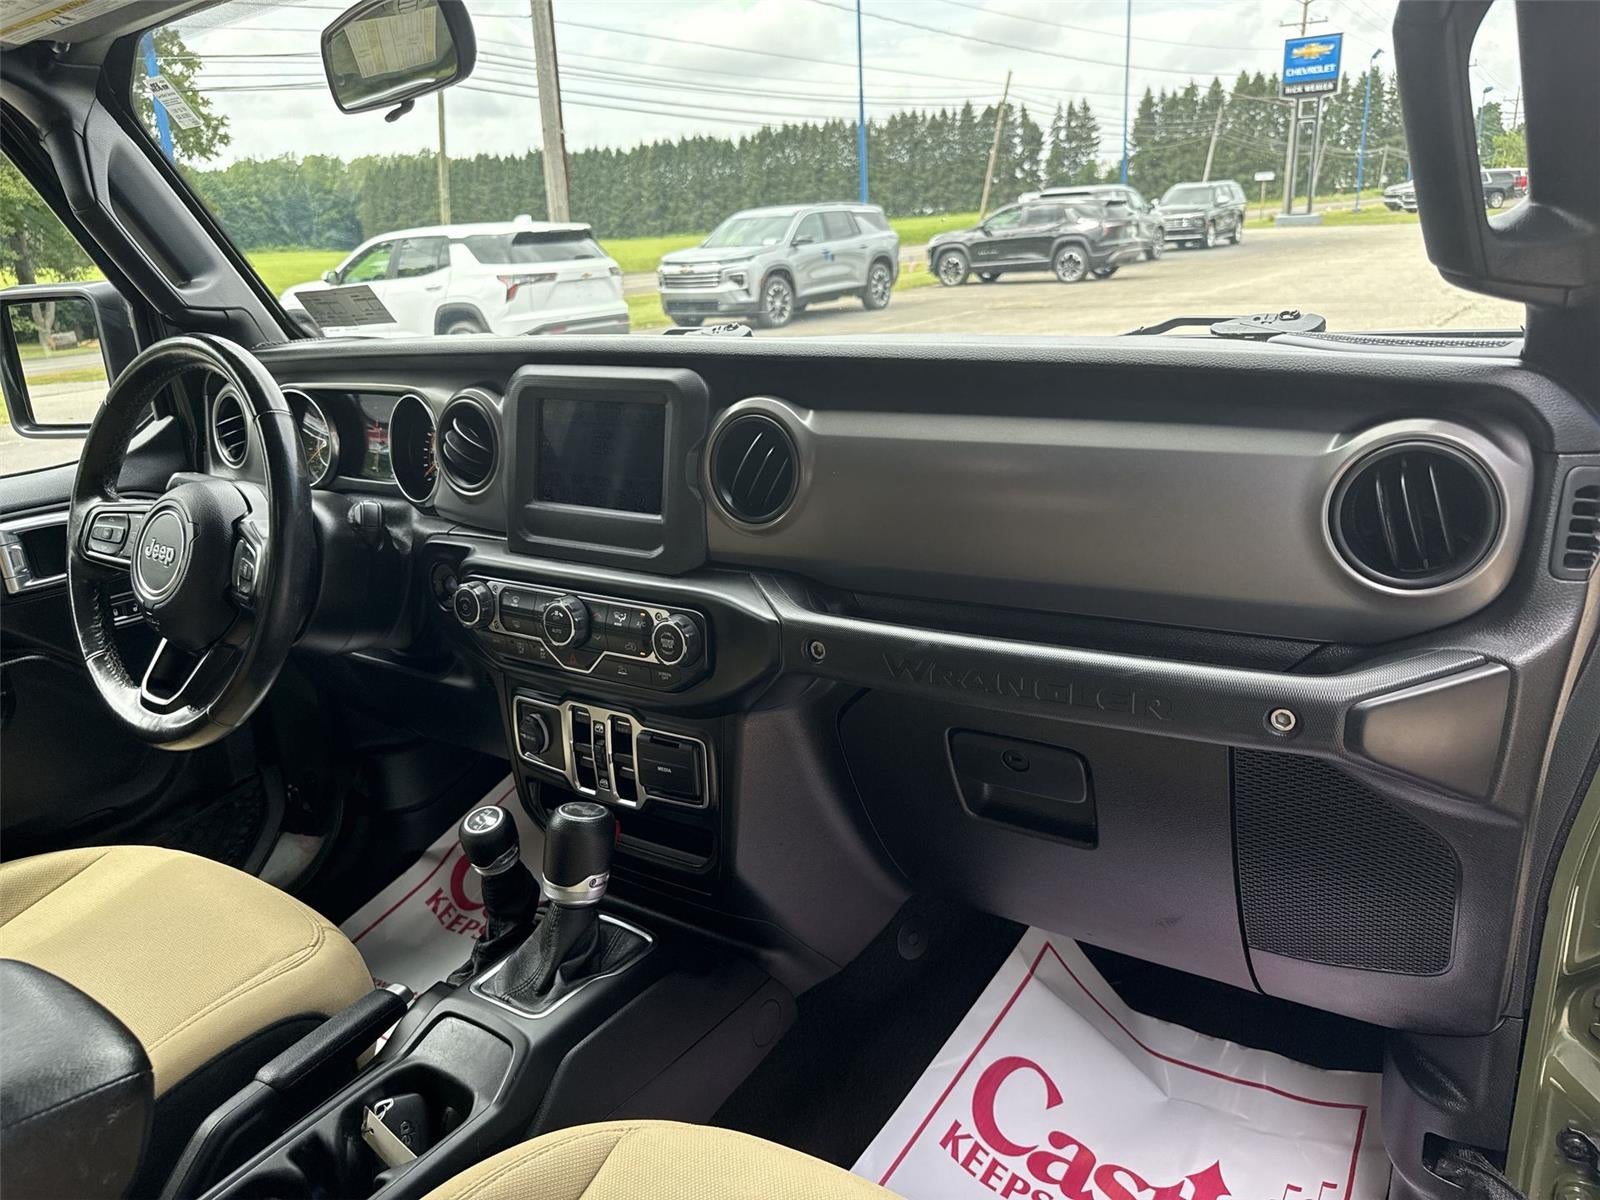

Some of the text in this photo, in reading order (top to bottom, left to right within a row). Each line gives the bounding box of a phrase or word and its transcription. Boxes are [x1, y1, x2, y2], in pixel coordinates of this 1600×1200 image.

[1285, 64, 1336, 77] CHEVROLET
[145, 537, 176, 567] Jeep
[882, 651, 1170, 720] WRANGLER
